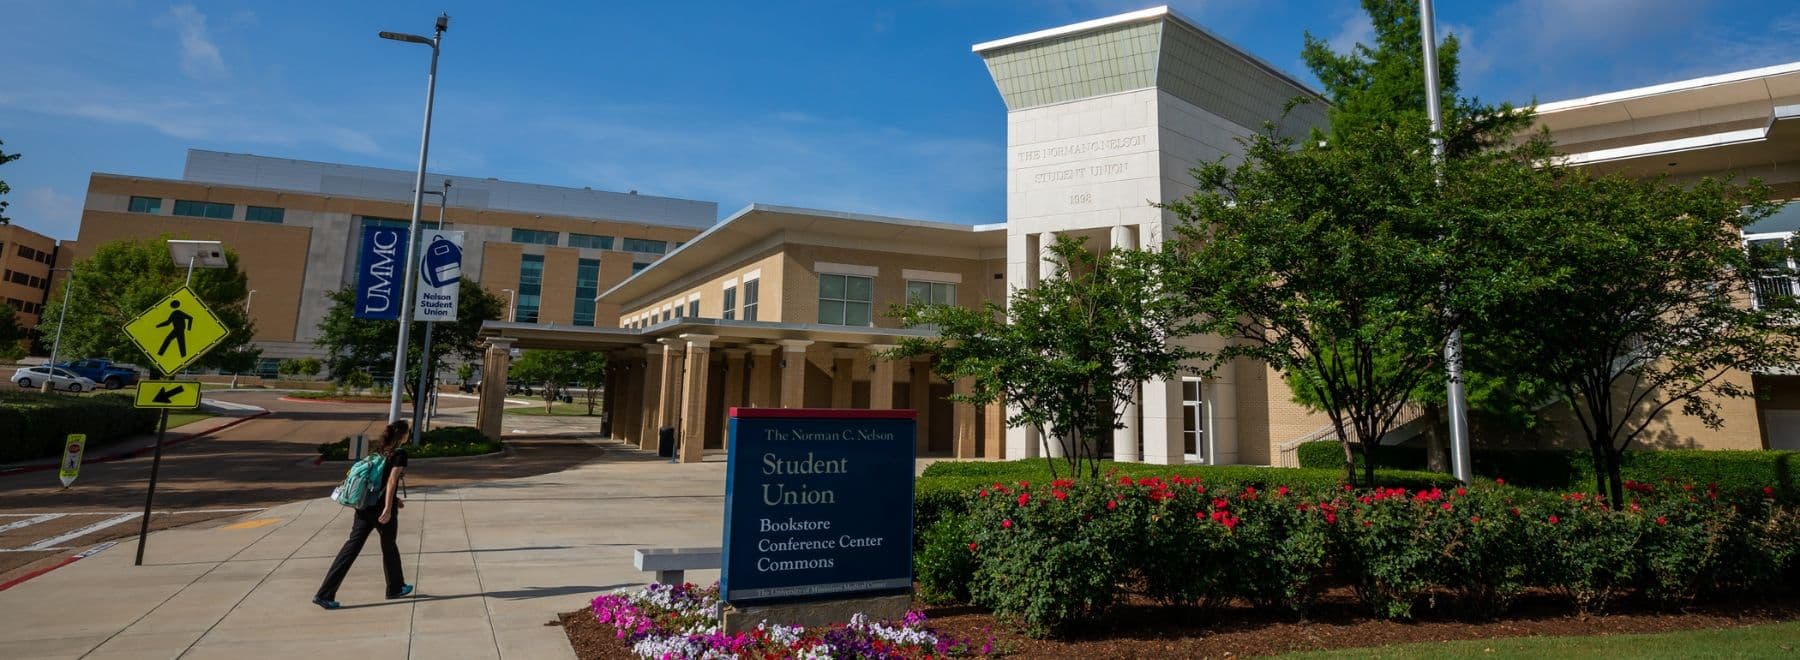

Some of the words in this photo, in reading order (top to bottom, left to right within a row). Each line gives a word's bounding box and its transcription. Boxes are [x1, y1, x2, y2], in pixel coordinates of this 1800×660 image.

[1017, 150, 1040, 161] THE
[1042, 142, 1091, 159] NORMAN
[1101, 135, 1147, 151] NELSON
[1035, 168, 1086, 184] STUDENT
[1090, 162, 1129, 177] UNION
[364, 231, 398, 314] UMMC
[420, 300, 453, 308] Student
[423, 292, 452, 301] Nelson
[423, 307, 448, 316] Union
[765, 428, 789, 441] The
[791, 429, 840, 441] Norman
[842, 429, 854, 441] C.
[857, 429, 895, 441] Nelson
[762, 452, 848, 475] Student
[762, 483, 835, 506] Union
[760, 518, 831, 533] Bookstore
[758, 537, 835, 552] Conference
[839, 534, 883, 548] Center
[757, 557, 834, 572] Commons
